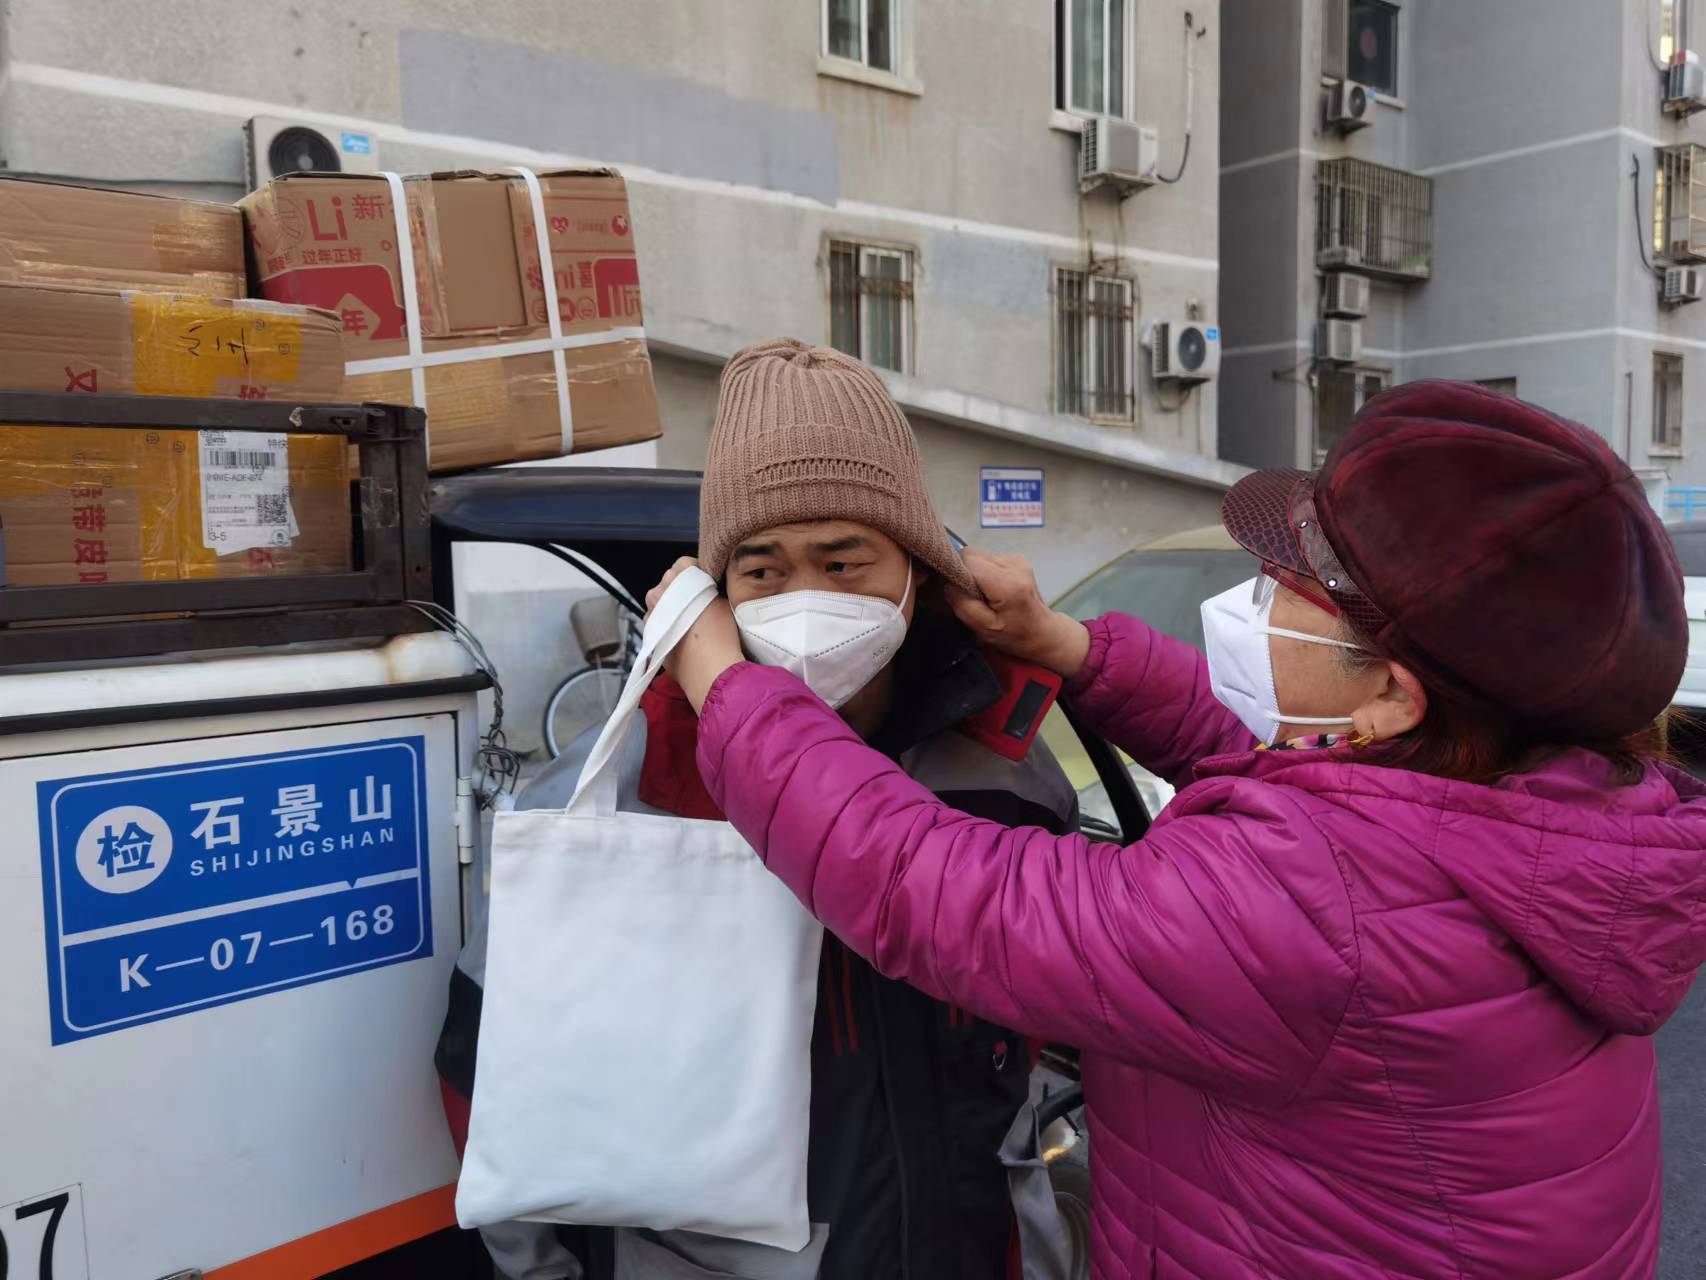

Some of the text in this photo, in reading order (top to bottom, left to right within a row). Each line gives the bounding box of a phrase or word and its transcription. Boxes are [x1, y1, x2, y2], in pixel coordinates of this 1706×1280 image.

[306, 196, 347, 241] Li
[190, 775, 391, 850] 石景山
[97, 821, 155, 878] 检
[190, 827, 394, 876] SHIJINGSHAN
[0, 1192, 70, 1280] 7
